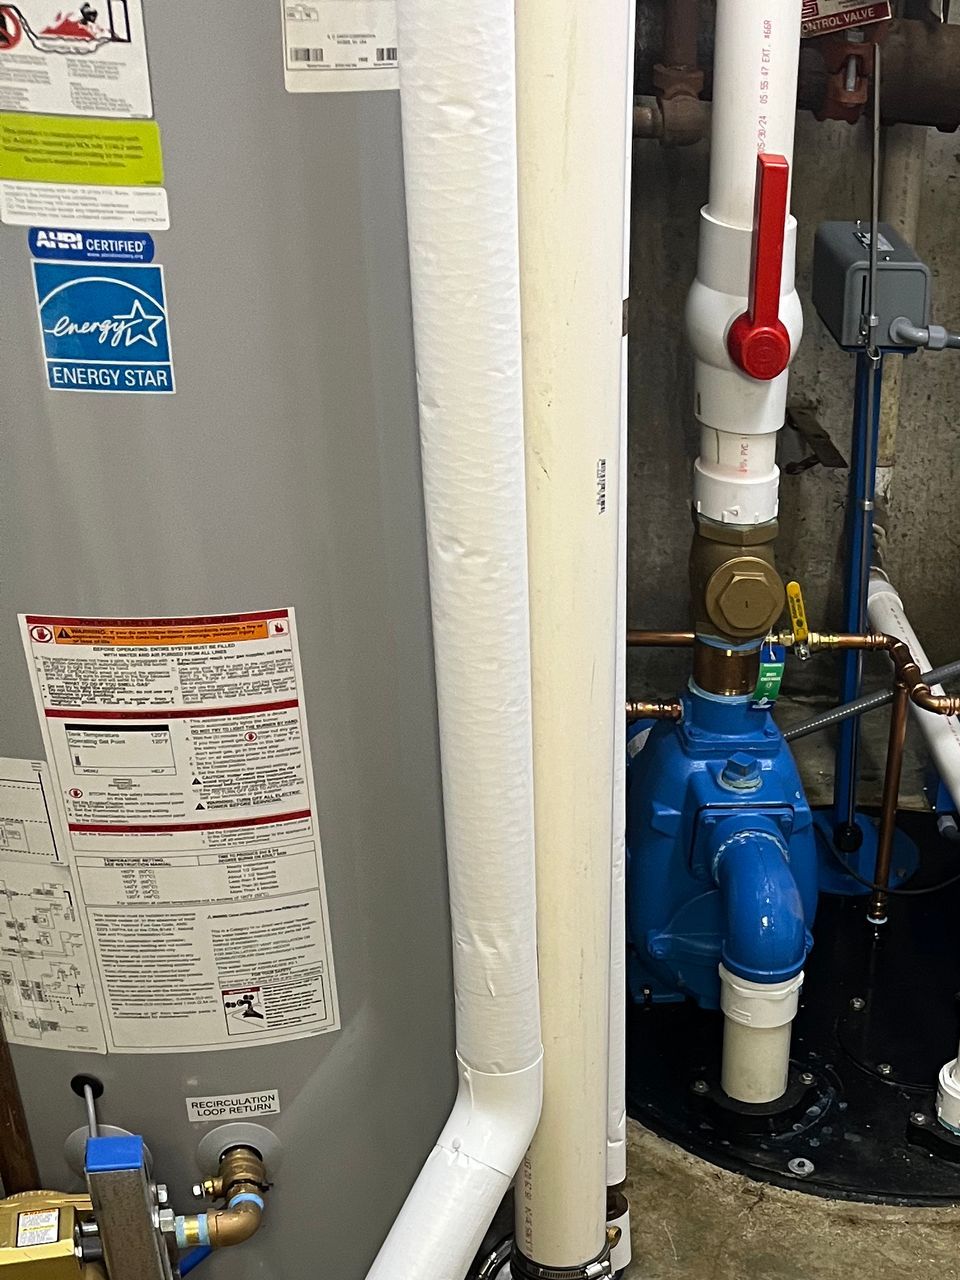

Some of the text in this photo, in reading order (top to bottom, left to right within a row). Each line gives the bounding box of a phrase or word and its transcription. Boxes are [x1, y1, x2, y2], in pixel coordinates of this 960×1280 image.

[802, 7, 875, 32] ONTROL VALVE
[36, 230, 143, 252] AHRI CERTIFIED
[44, 316, 134, 347] energy
[53, 366, 168, 387] ENERGY STAR
[191, 1094, 275, 1110] RECIRCULATION
[197, 1103, 272, 1117] LOOP RETURN
